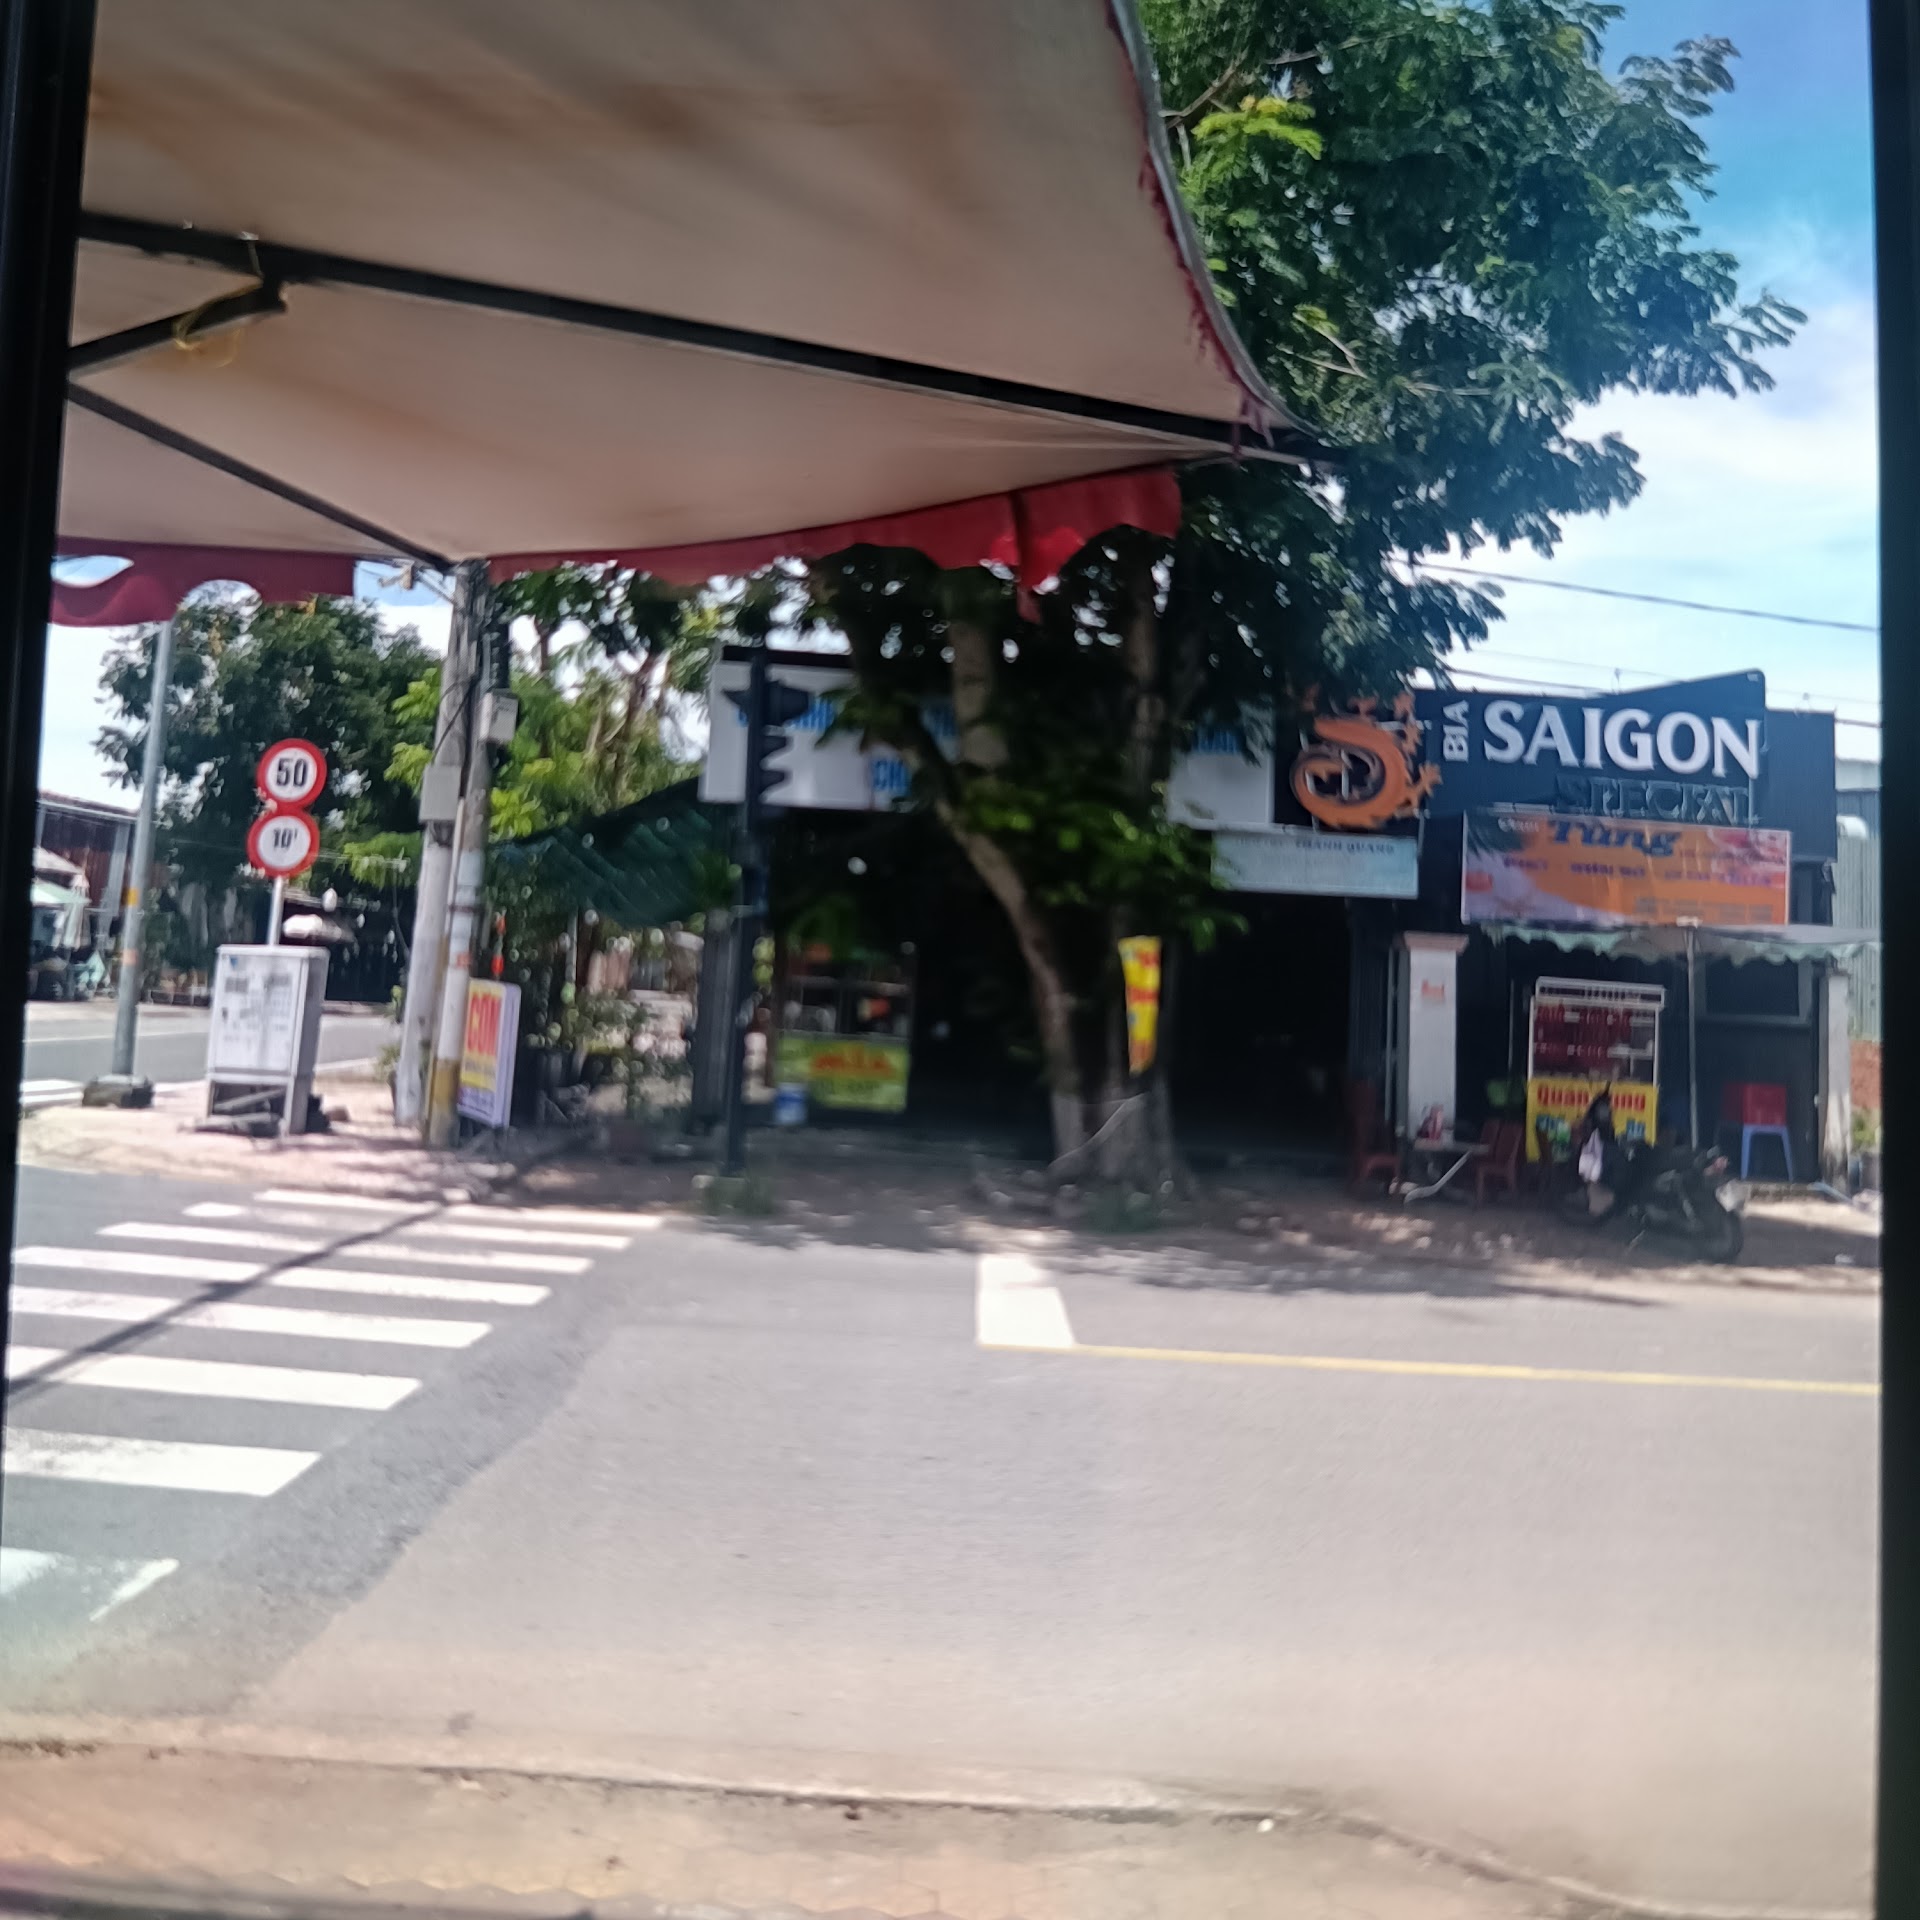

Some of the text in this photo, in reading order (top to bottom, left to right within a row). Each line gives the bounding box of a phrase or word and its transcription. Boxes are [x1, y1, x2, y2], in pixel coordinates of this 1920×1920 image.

[1442, 699, 1469, 763] BIA
[1483, 699, 1759, 779] SAIGON
[275, 757, 309, 787] 50
